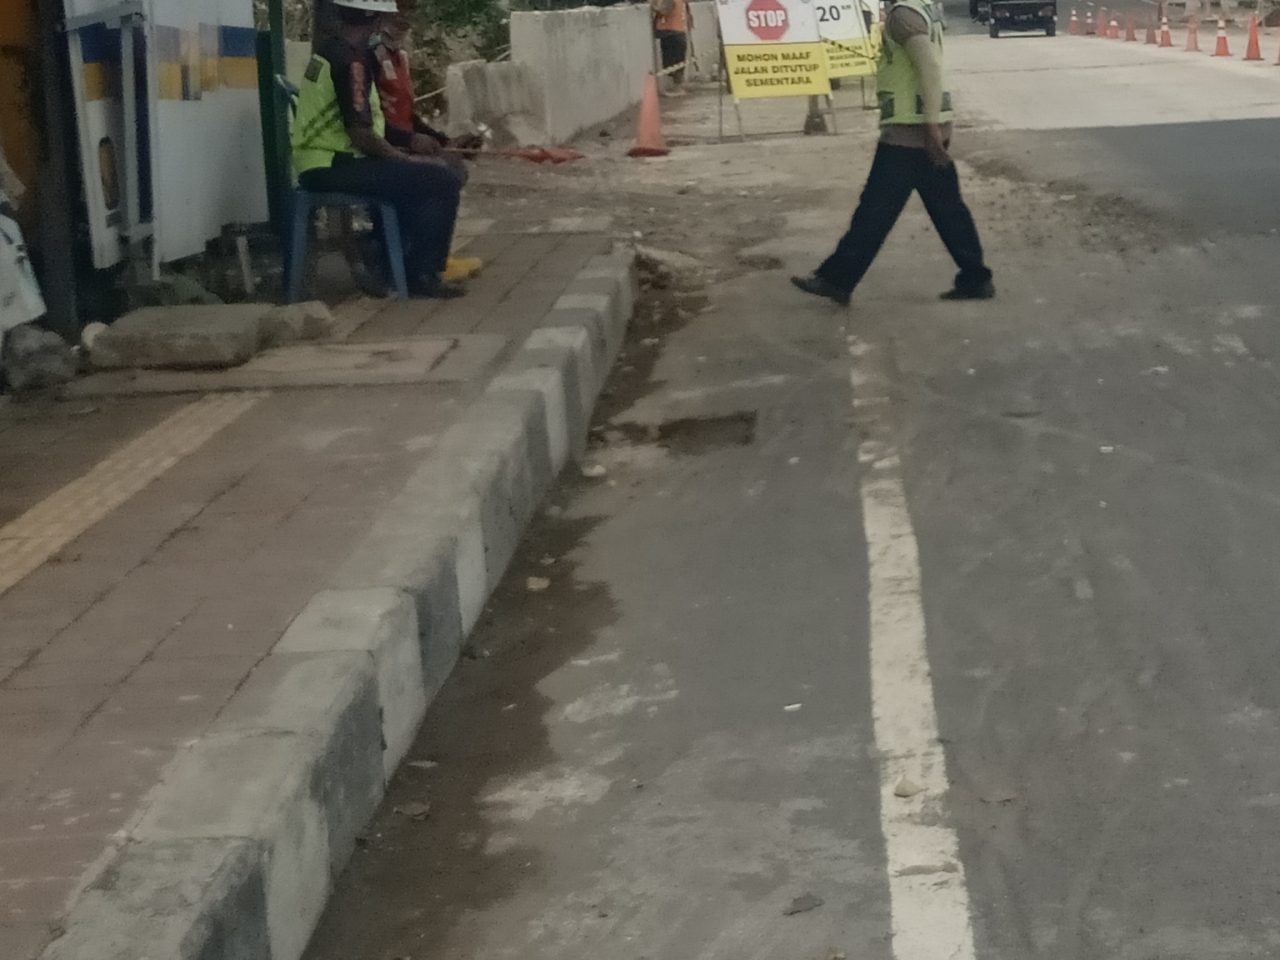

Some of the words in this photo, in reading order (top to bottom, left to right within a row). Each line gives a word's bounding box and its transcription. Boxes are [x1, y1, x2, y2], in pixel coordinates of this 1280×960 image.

[748, 10, 786, 28] STOP
[816, 5, 840, 22] 20
[736, 53, 778, 62] MOHON
[781, 51, 812, 61] MAAF
[733, 65, 769, 75] JALAN
[771, 63, 820, 74] DITUTUP
[745, 76, 812, 87] SEMENTARA
